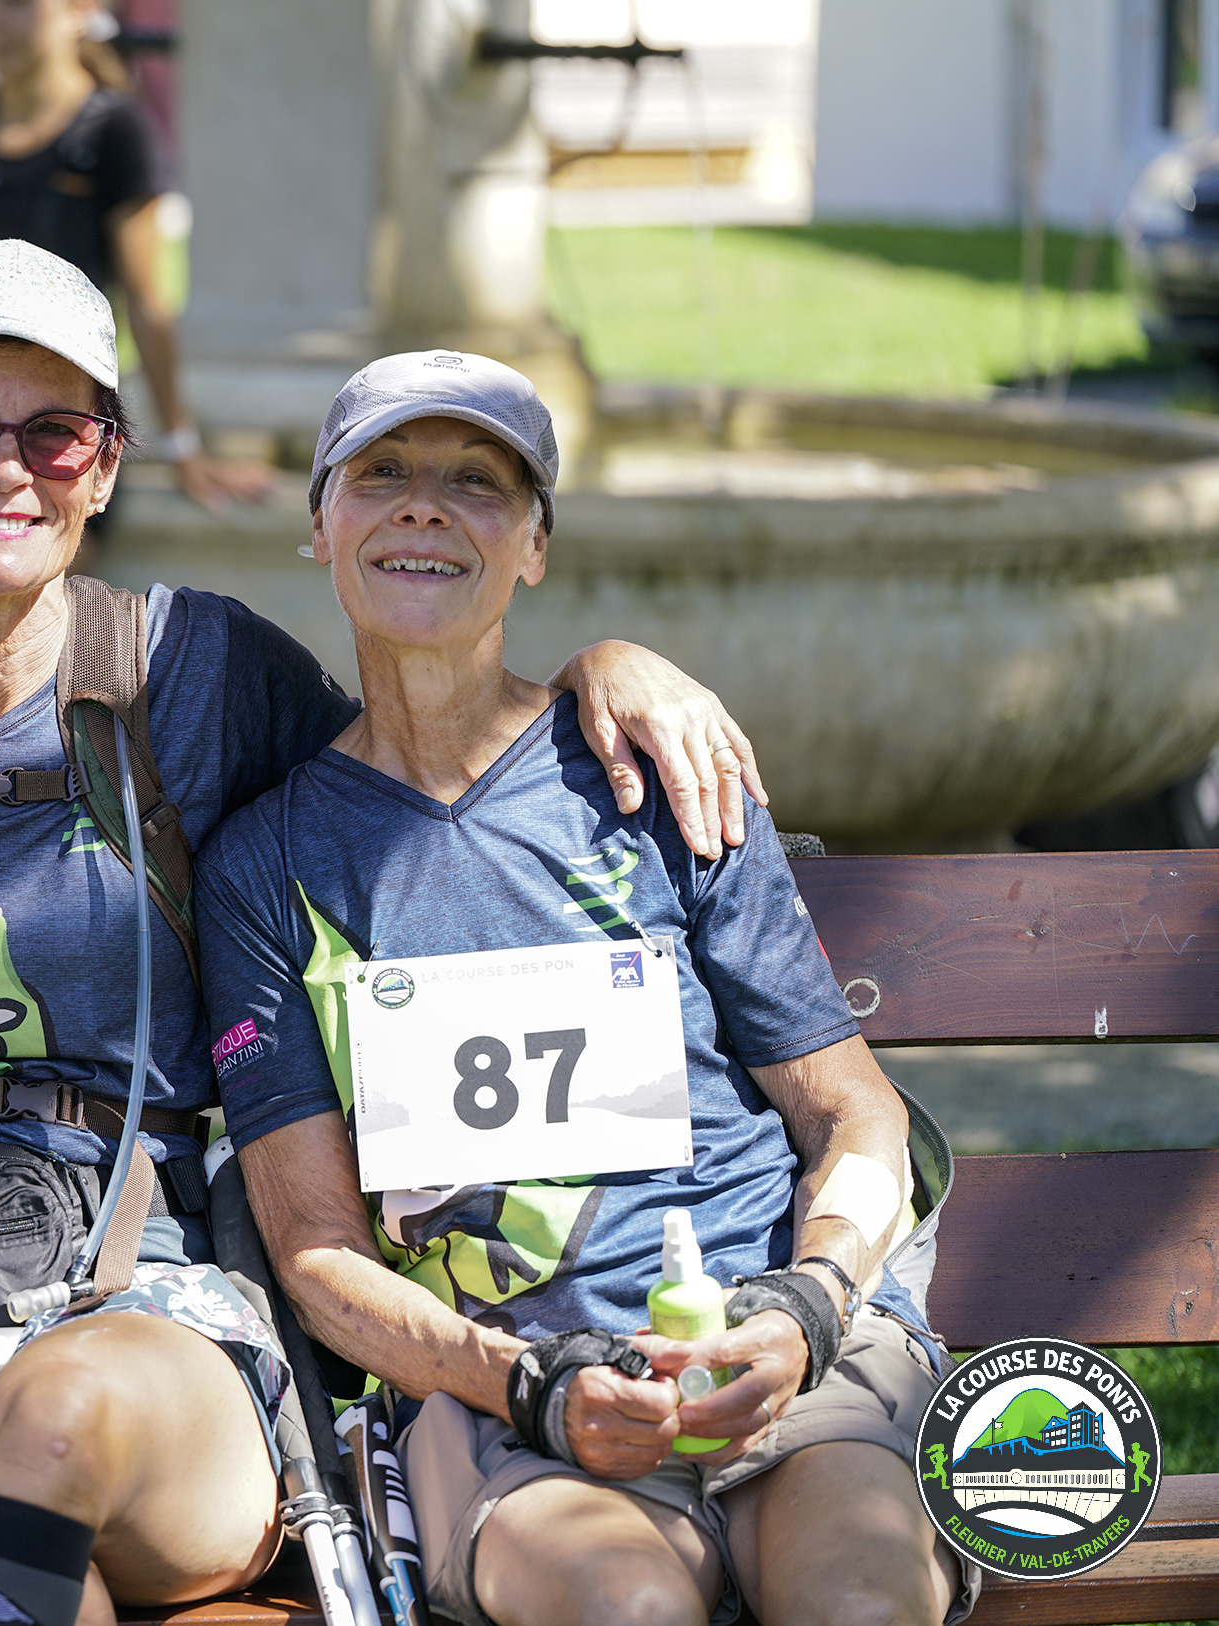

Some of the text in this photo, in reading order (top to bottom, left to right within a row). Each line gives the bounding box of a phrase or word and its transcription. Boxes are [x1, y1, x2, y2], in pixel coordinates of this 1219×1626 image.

[421, 971, 440, 983] LA
[446, 966, 505, 981] COURSE
[511, 962, 539, 975] DES
[453, 1028, 587, 1130] 87
